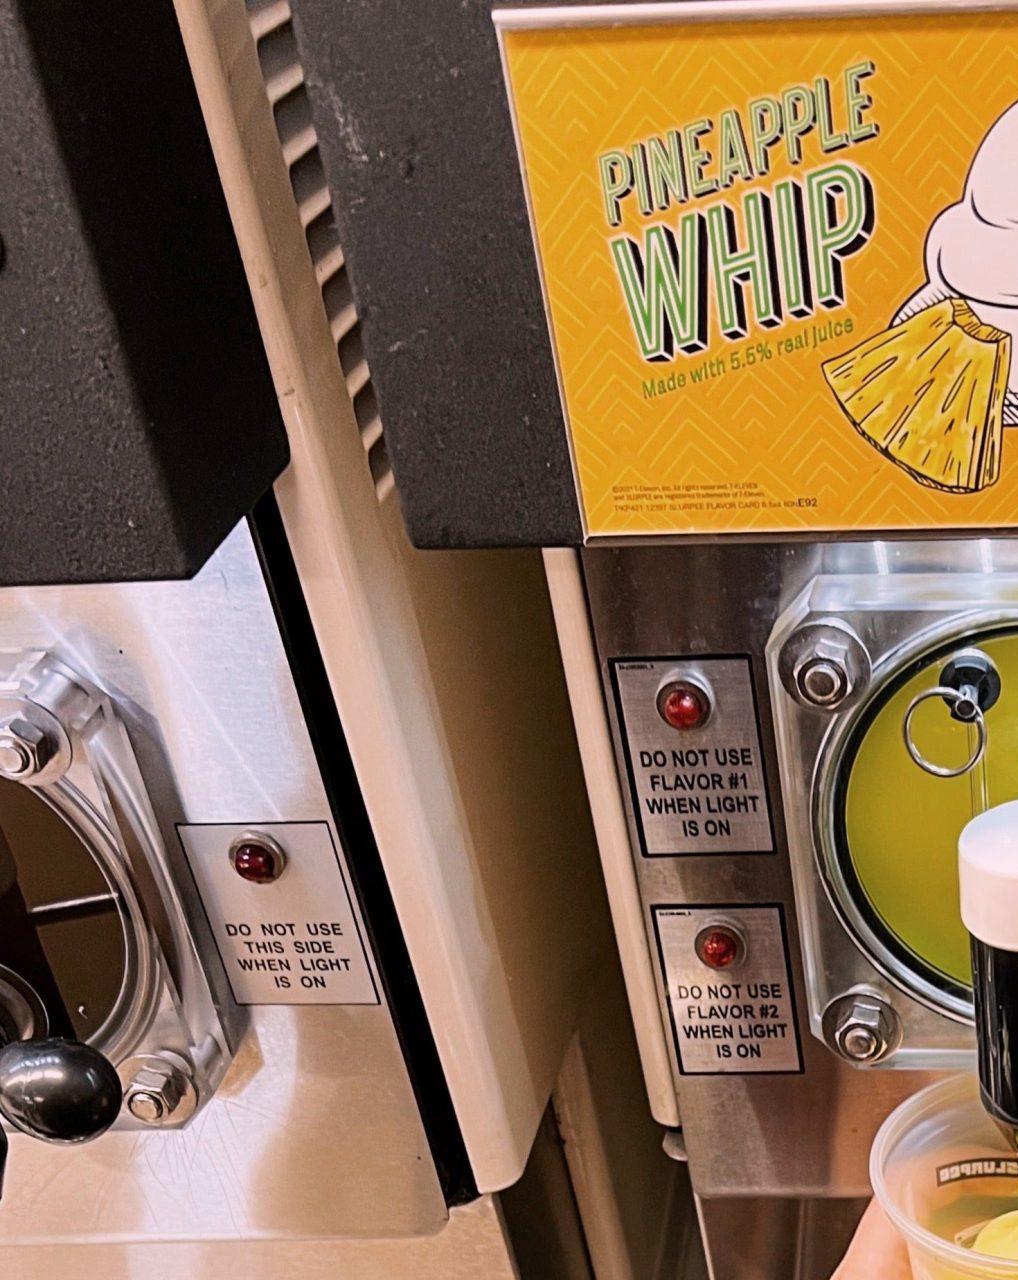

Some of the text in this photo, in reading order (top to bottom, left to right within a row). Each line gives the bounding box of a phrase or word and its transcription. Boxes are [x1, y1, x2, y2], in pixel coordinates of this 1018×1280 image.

[598, 60, 880, 228] PINEAPPLE
[609, 160, 876, 363] WHIP
[641, 317, 855, 400] Made with 5.5% real juice
[707, 501, 736, 510] FLAVOR
[738, 501, 760, 509] CARD
[639, 748, 752, 767] DO NOT USE
[650, 773, 748, 791] FLAVOR #1
[645, 796, 759, 814] WHEN LIGHT
[682, 819, 731, 837] IS ON
[225, 923, 343, 936] DO NOT USE
[244, 941, 335, 953] THIS SIDE
[237, 958, 350, 971] WHEN LIGHT
[274, 976, 326, 988] IS ON
[678, 984, 782, 1000] DO NOT USE
[687, 1004, 779, 1019] FLAVOR #2
[683, 1023, 787, 1039] WHEN LIGHT
[716, 1043, 762, 1058] IS ON
